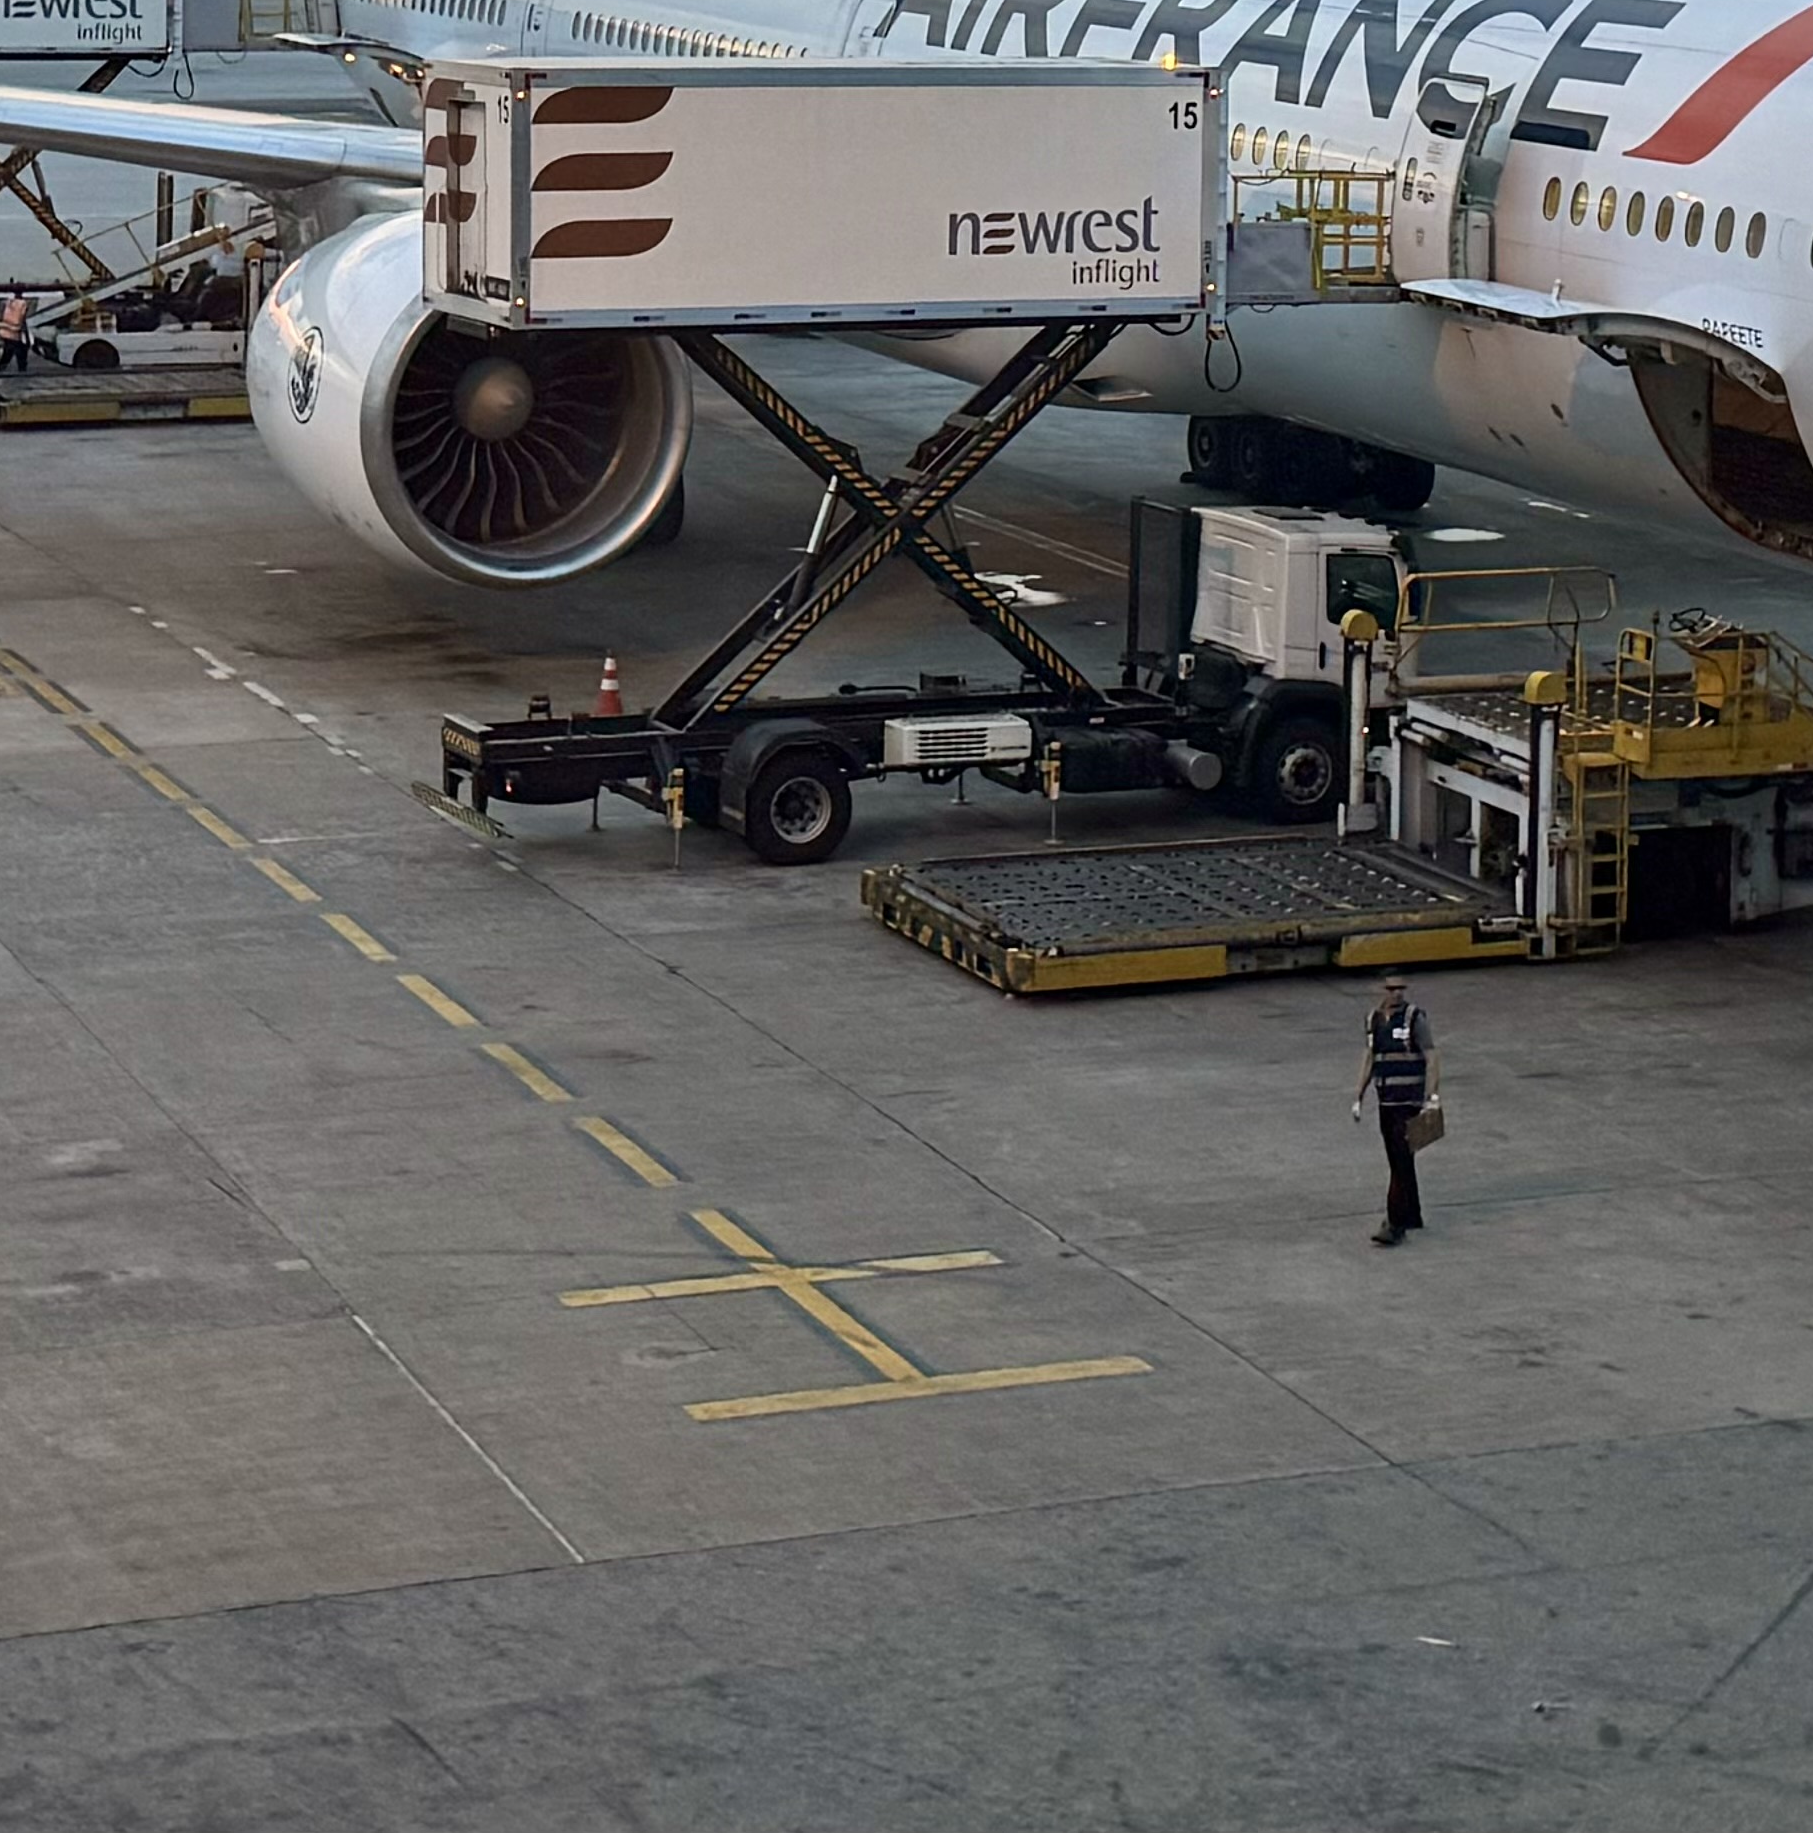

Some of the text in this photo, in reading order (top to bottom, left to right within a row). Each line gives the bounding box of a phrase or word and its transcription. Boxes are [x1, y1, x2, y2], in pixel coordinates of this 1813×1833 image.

[76, 22, 143, 46] inflight
[496, 94, 510, 124] 15
[1167, 101, 1199, 130] 15
[947, 194, 1161, 256] newrest
[1071, 258, 1161, 291] inflight
